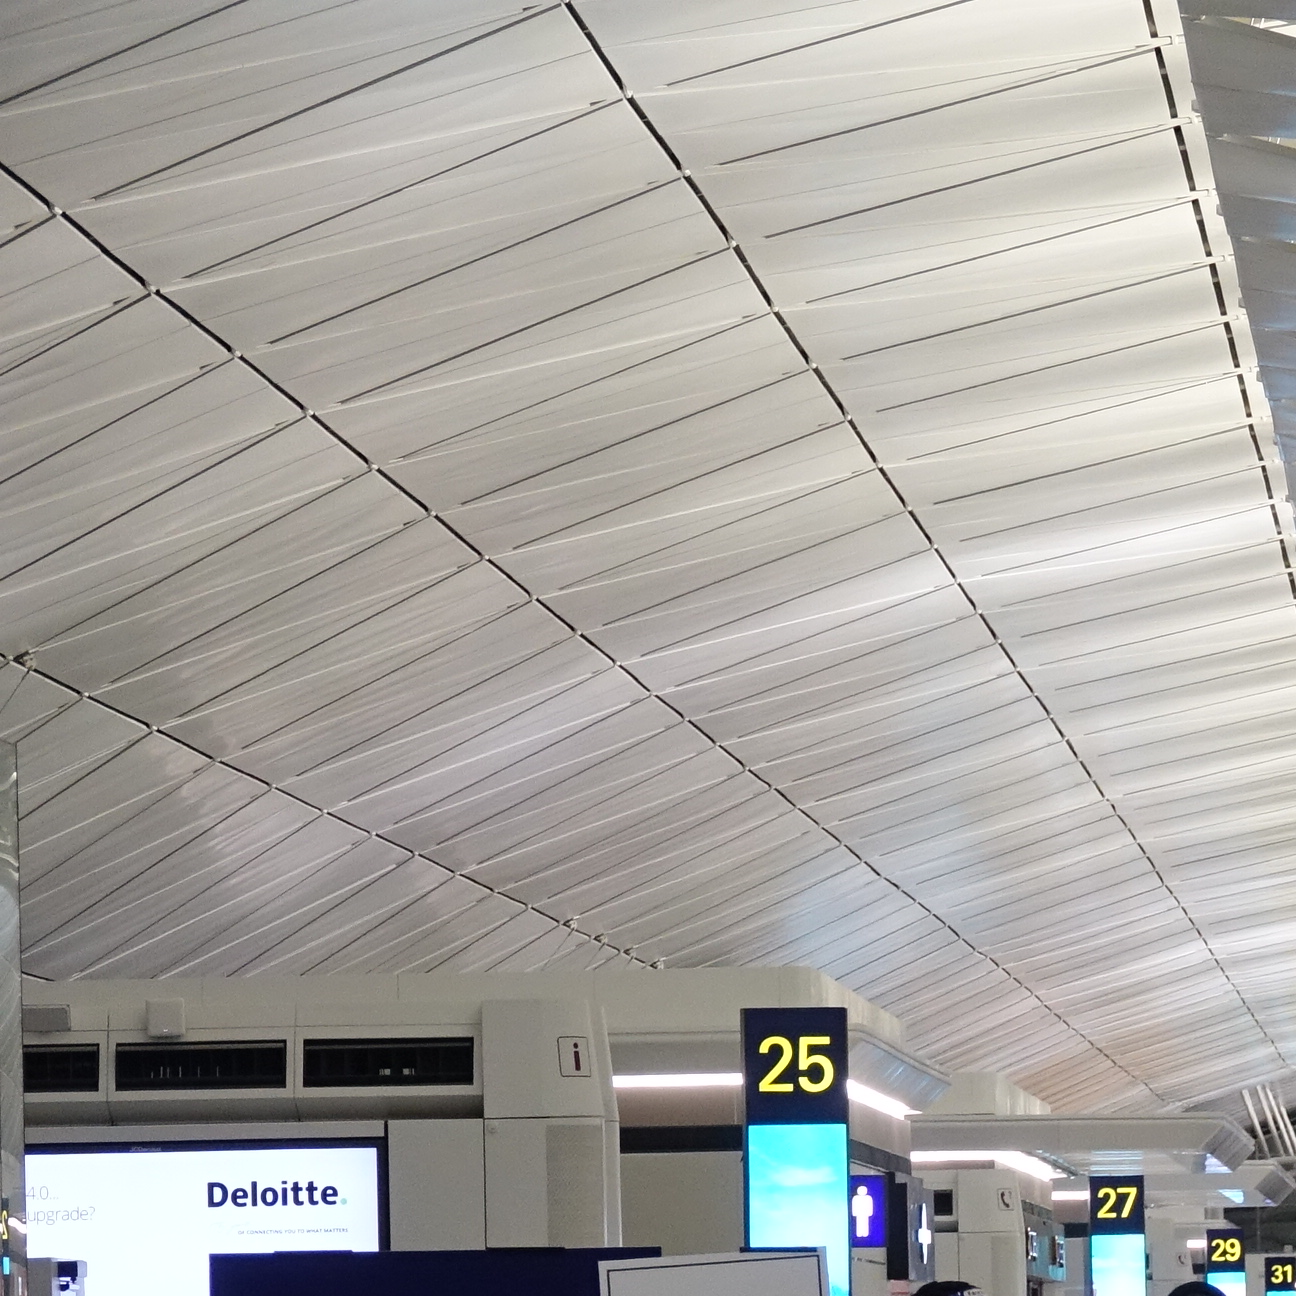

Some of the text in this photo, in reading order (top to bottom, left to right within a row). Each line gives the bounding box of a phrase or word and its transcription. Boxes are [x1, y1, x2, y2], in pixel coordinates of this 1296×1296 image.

[758, 1036, 834, 1092] 25
[27, 1206, 96, 1223] upgrade?
[1097, 1187, 1137, 1218] 27
[1211, 1238, 1241, 1262] 29
[1271, 1264, 1293, 1284] 31
